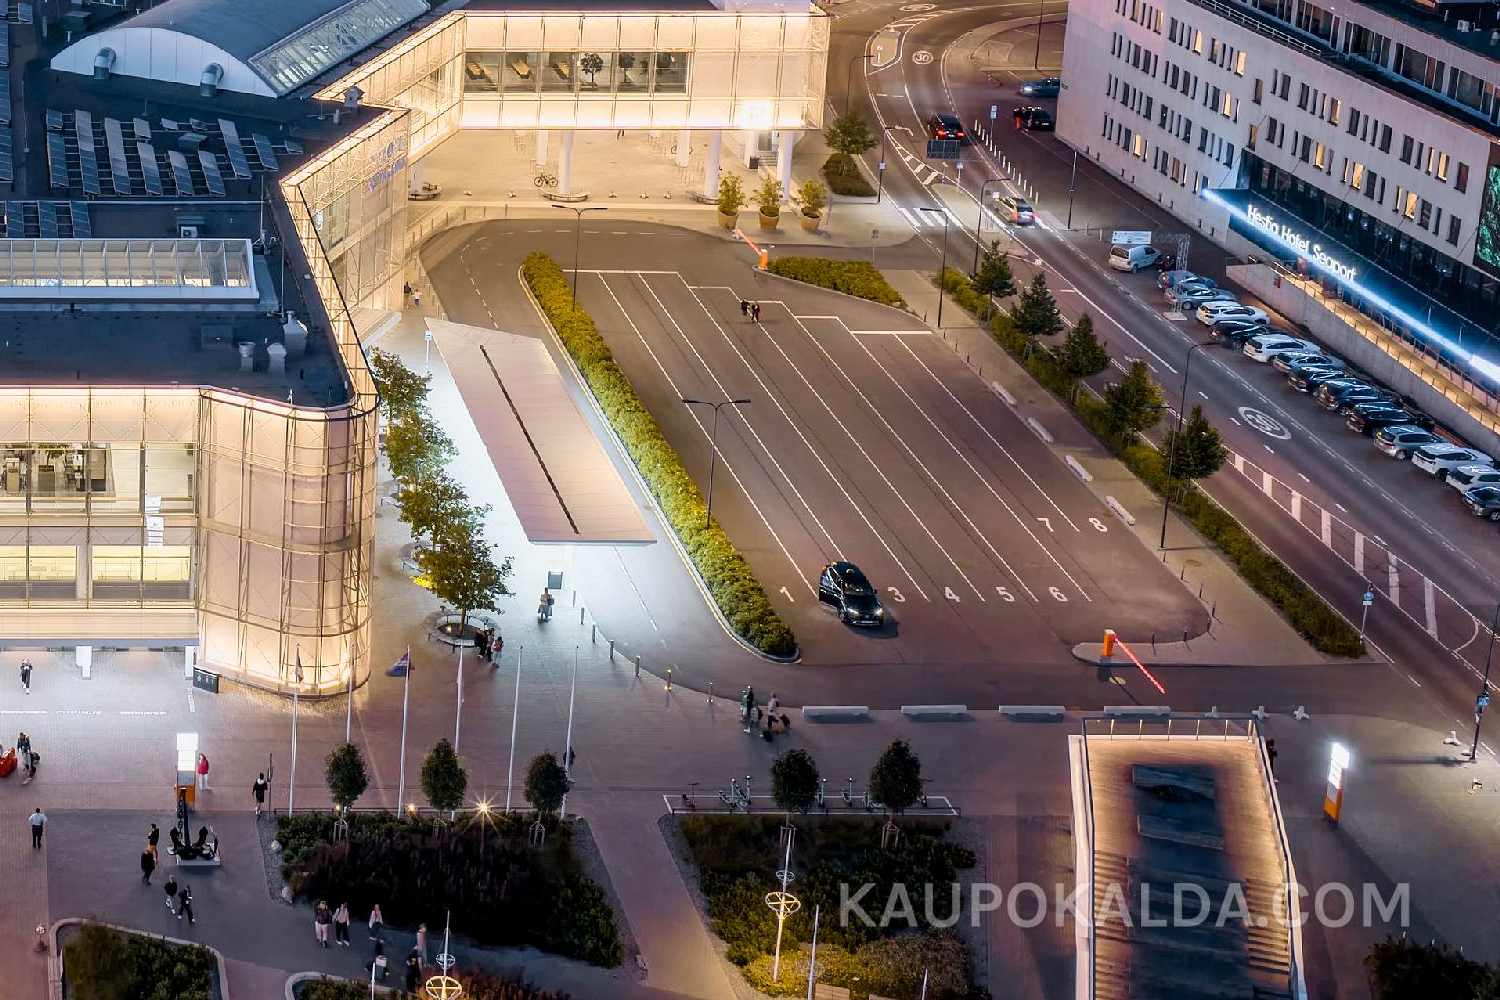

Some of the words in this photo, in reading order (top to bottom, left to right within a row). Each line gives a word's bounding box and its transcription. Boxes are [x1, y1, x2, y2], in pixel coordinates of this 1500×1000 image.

[1247, 204, 1279, 235] Hestia
[1281, 225, 1311, 252] Hotel
[1312, 244, 1357, 280] Seaport
[1036, 517, 1054, 532] 7
[1088, 517, 1108, 532] 8
[780, 586, 794, 602] 1
[887, 586, 906, 602] 3
[944, 586, 960, 602] 4
[995, 586, 1015, 602] 5
[1048, 586, 1068, 602] 6
